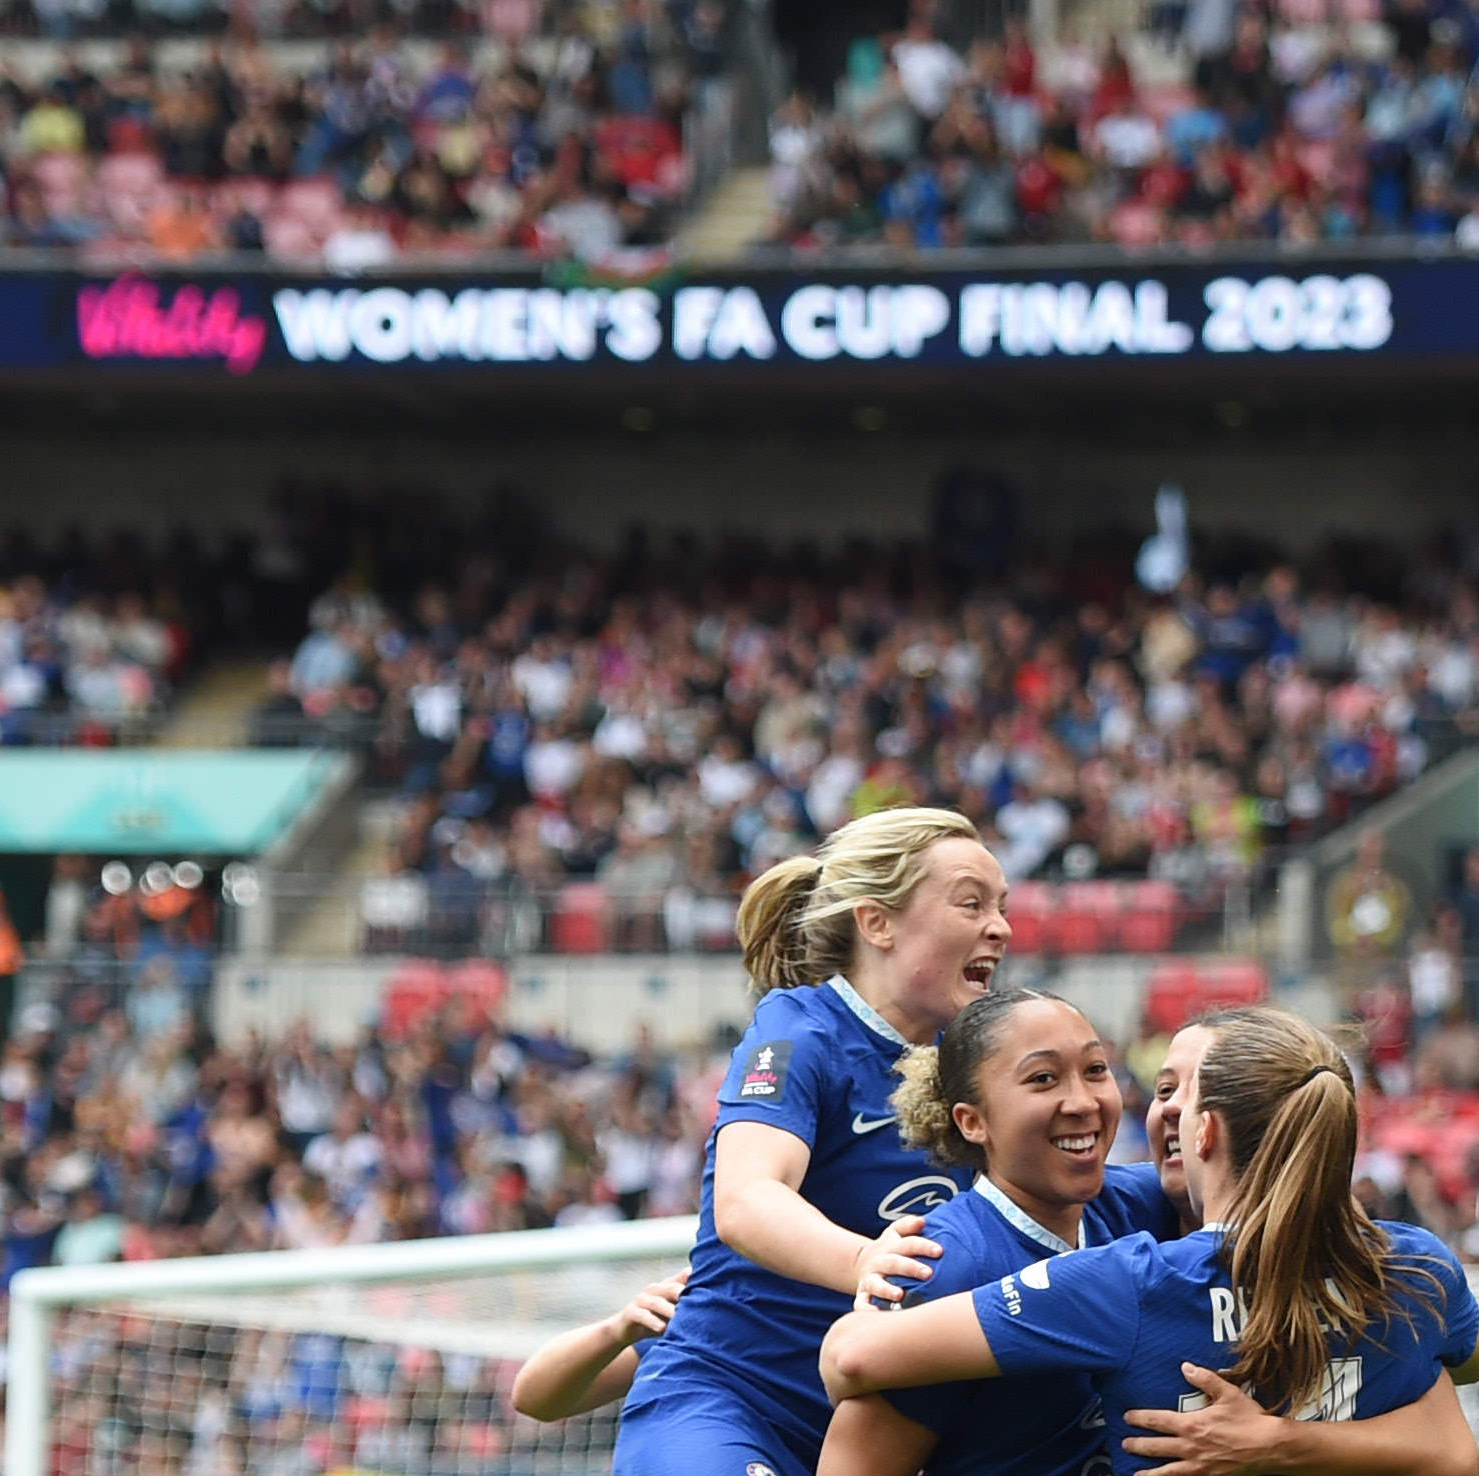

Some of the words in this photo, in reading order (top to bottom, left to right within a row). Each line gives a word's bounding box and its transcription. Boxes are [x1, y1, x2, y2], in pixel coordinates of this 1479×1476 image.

[273, 287, 662, 362] WOMEN'S
[672, 286, 777, 360] FA
[782, 284, 950, 360] CUP
[958, 280, 1194, 357] FINAL
[1202, 274, 1394, 353] 2023
